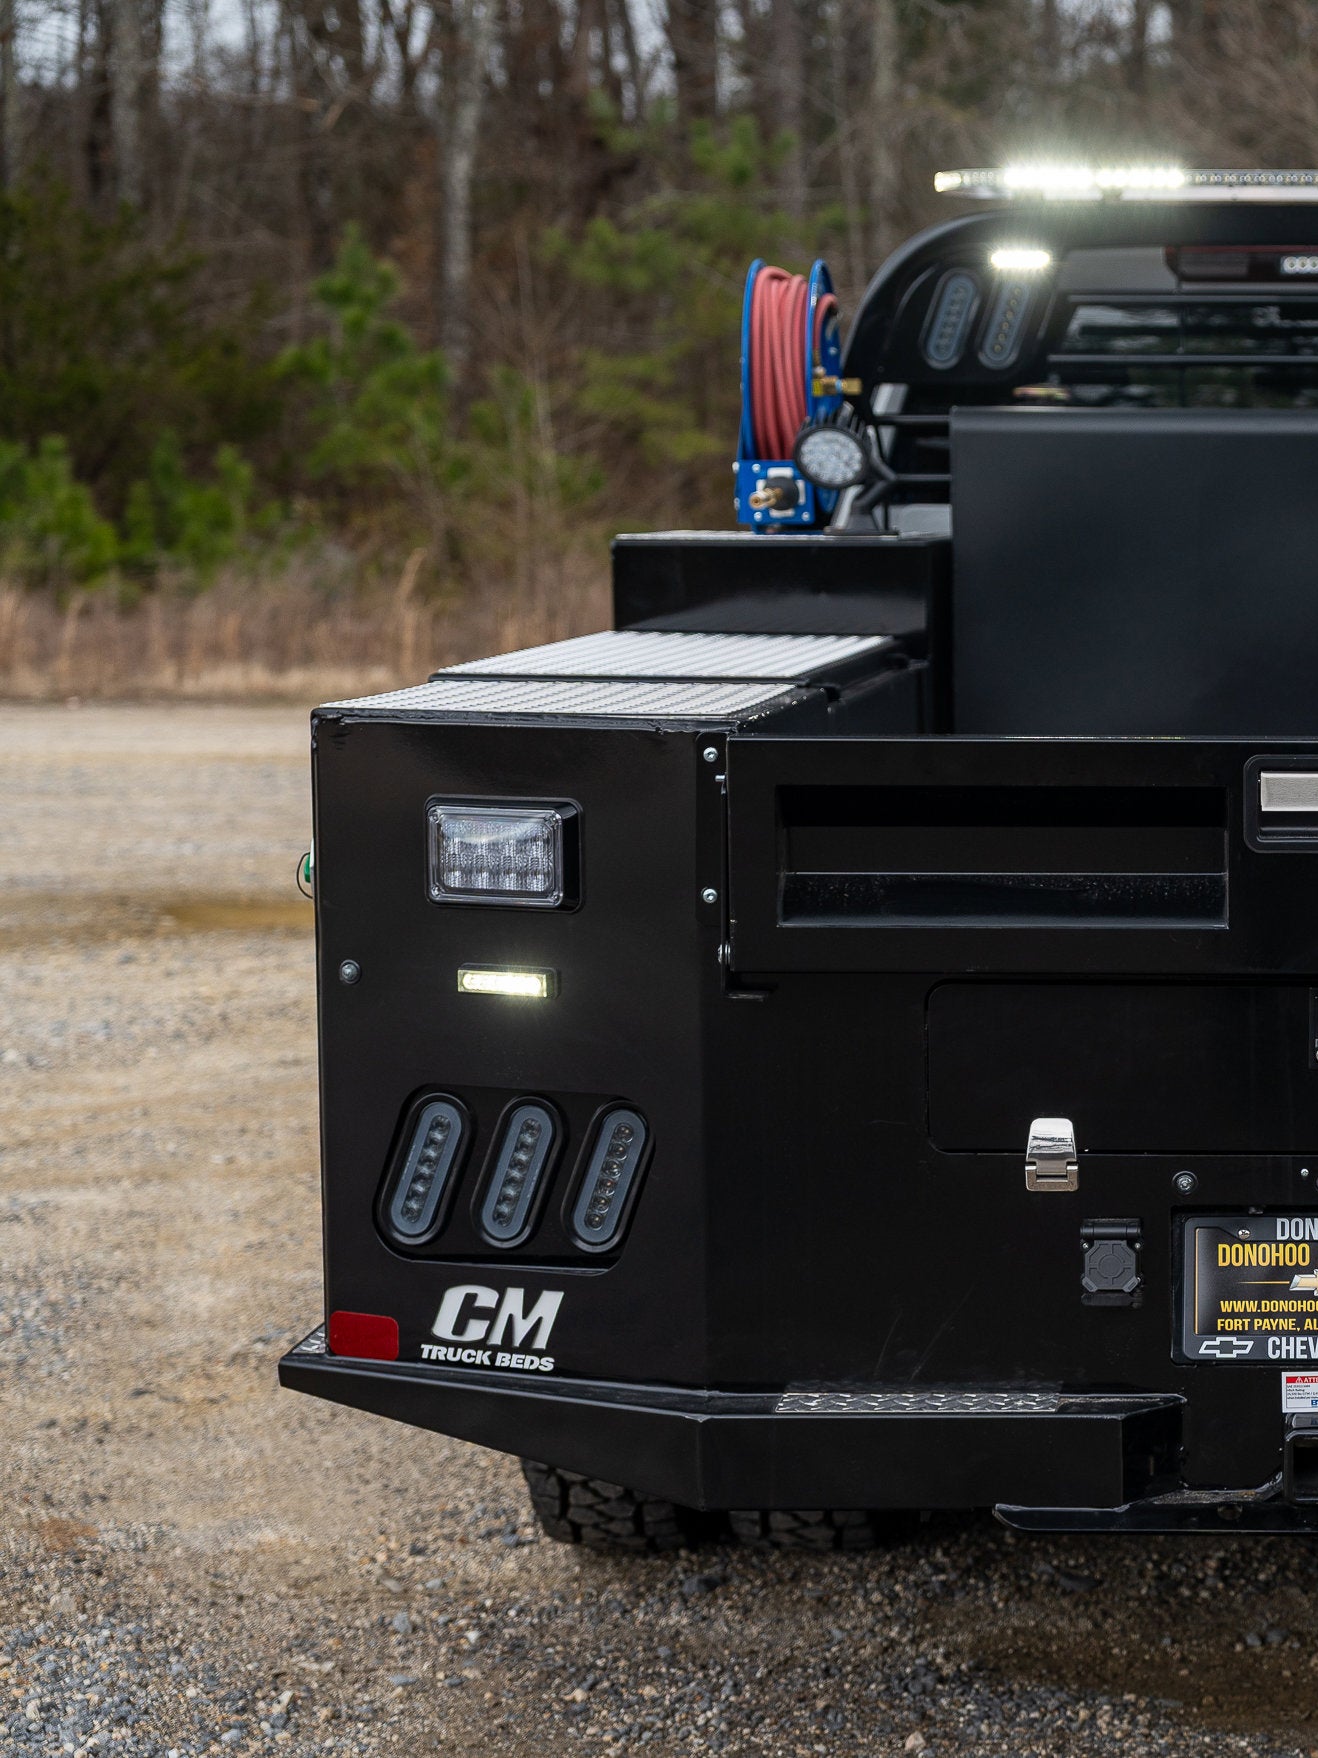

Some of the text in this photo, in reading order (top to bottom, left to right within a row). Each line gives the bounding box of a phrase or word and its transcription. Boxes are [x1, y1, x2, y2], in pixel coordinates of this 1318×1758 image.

[1218, 1243, 1311, 1267] DONOHOO
[430, 1284, 565, 1350] CM
[1217, 1318, 1251, 1331] FORT
[1253, 1318, 1301, 1333] PAYNE,
[420, 1343, 555, 1372] TRUCK BEDS
